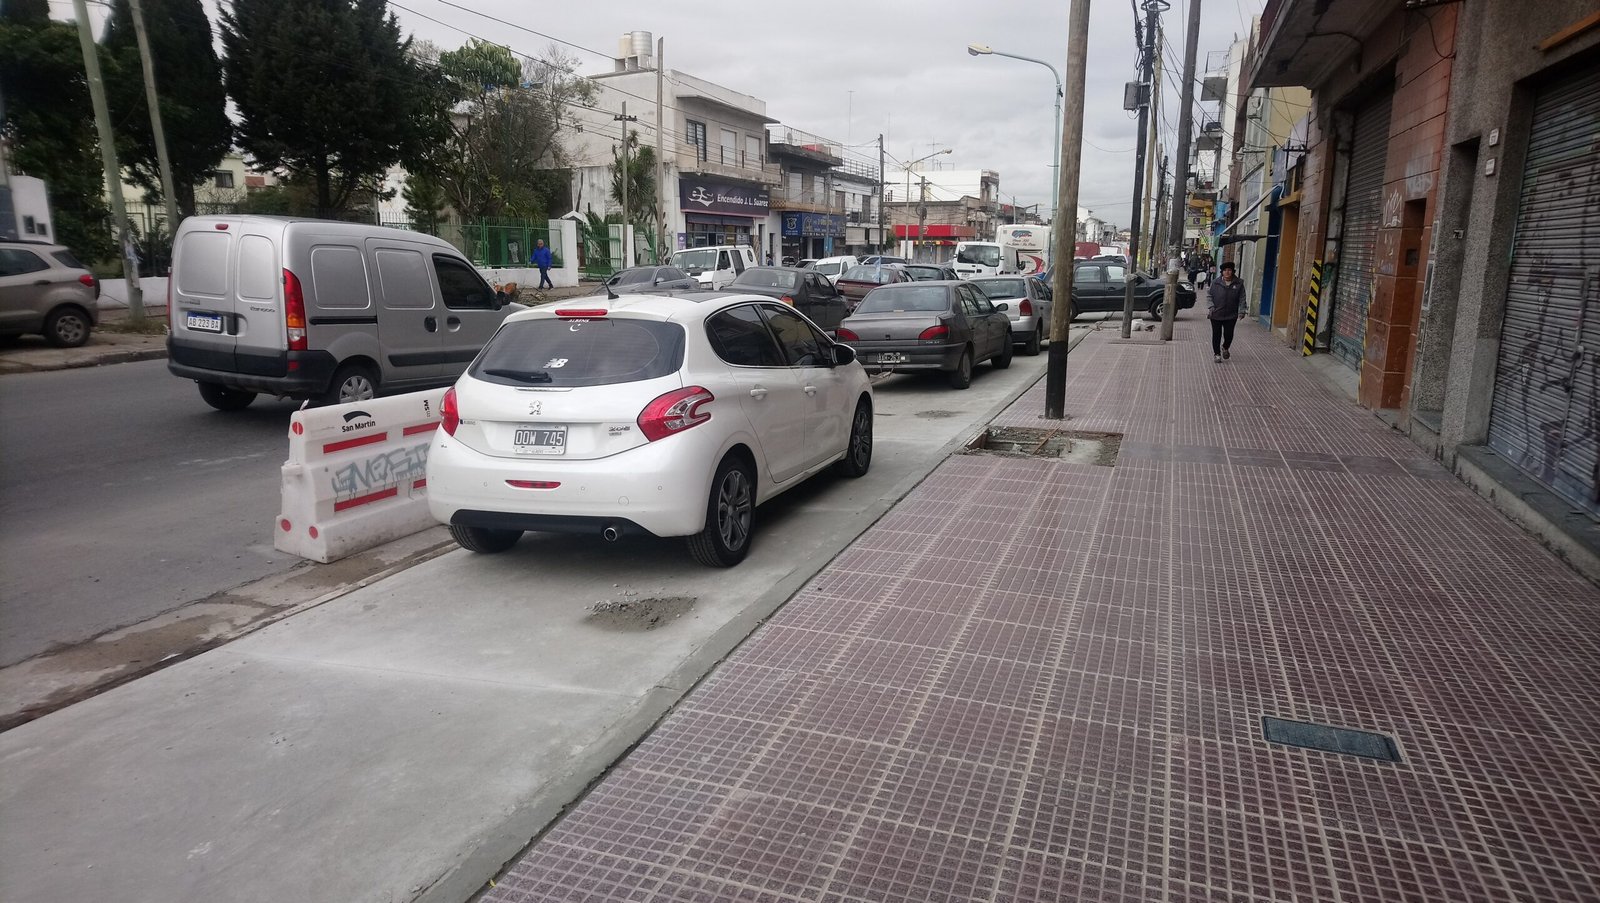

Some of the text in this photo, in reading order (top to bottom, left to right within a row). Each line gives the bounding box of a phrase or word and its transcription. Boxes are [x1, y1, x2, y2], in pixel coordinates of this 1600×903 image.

[717, 194, 743, 205] Encendido
[188, 317, 219, 329] AB 223 BA
[341, 425, 354, 433] San
[543, 431, 564, 446] 745
